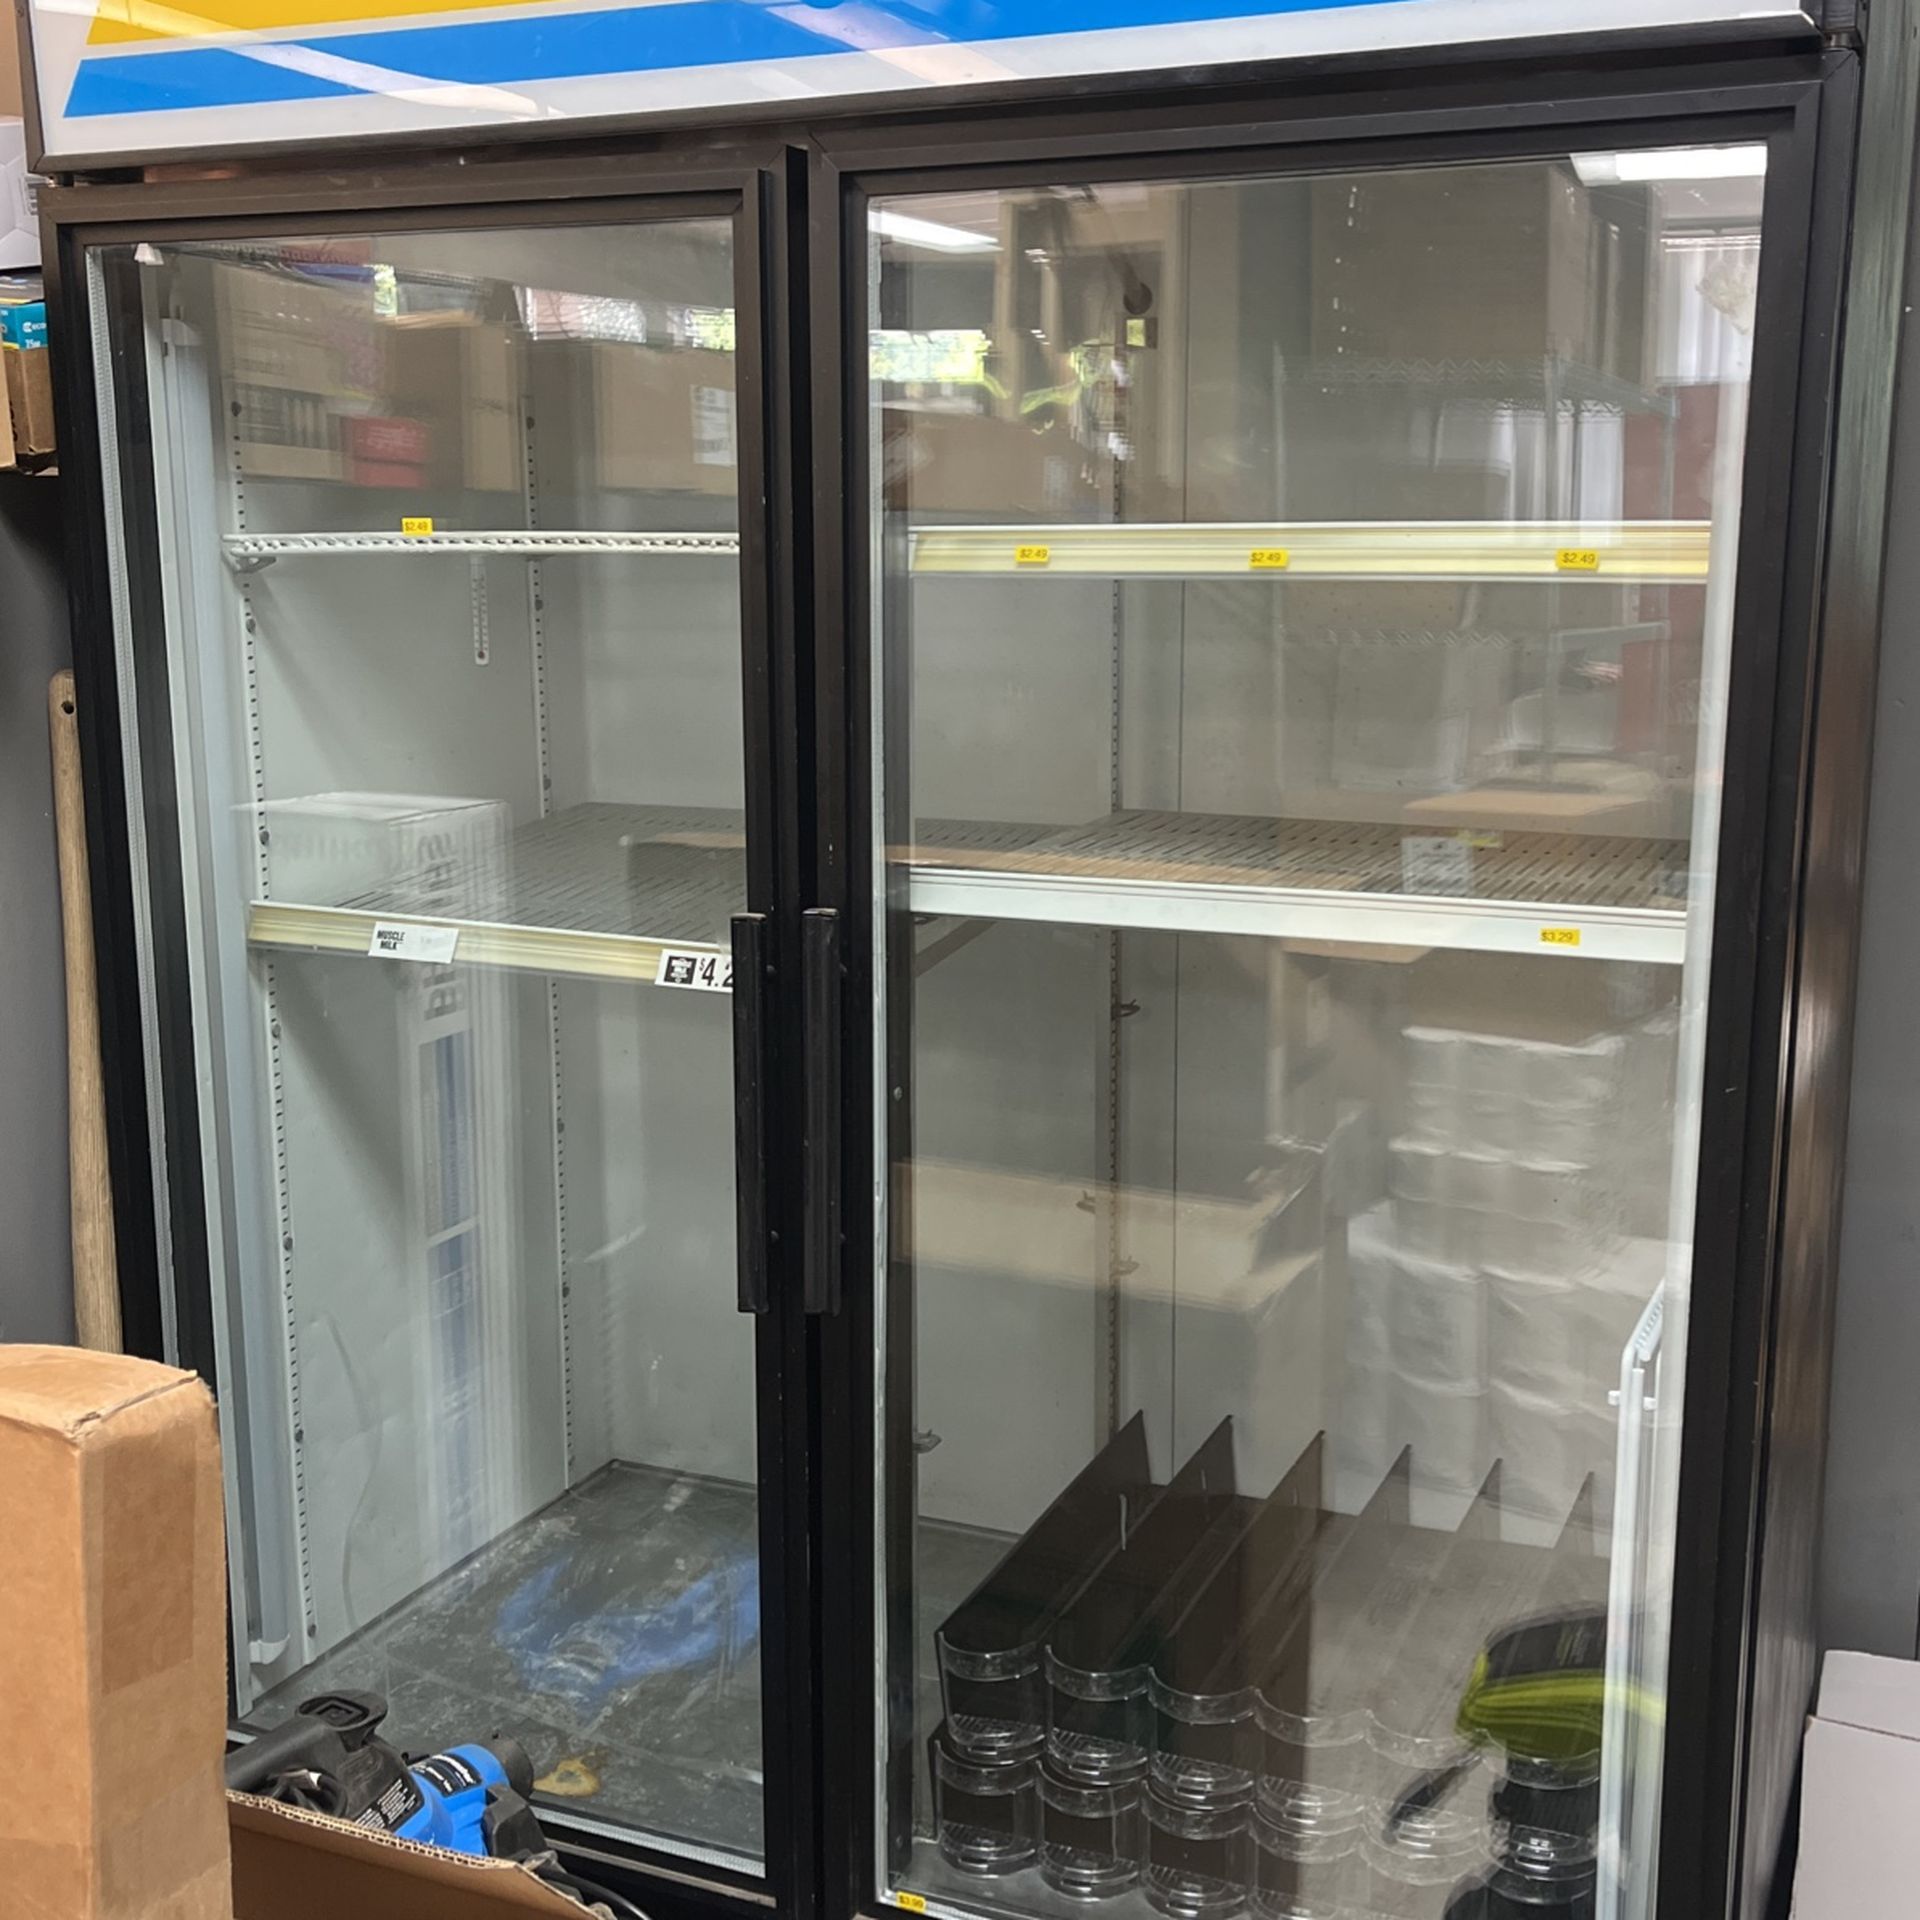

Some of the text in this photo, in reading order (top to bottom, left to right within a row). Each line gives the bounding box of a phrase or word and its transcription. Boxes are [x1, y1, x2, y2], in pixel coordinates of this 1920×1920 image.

[1020, 548, 1048, 560] $2.49
[1251, 552, 1281, 564] $2.49
[1562, 552, 1596, 565] $2.49
[1541, 931, 1573, 943] $3.29
